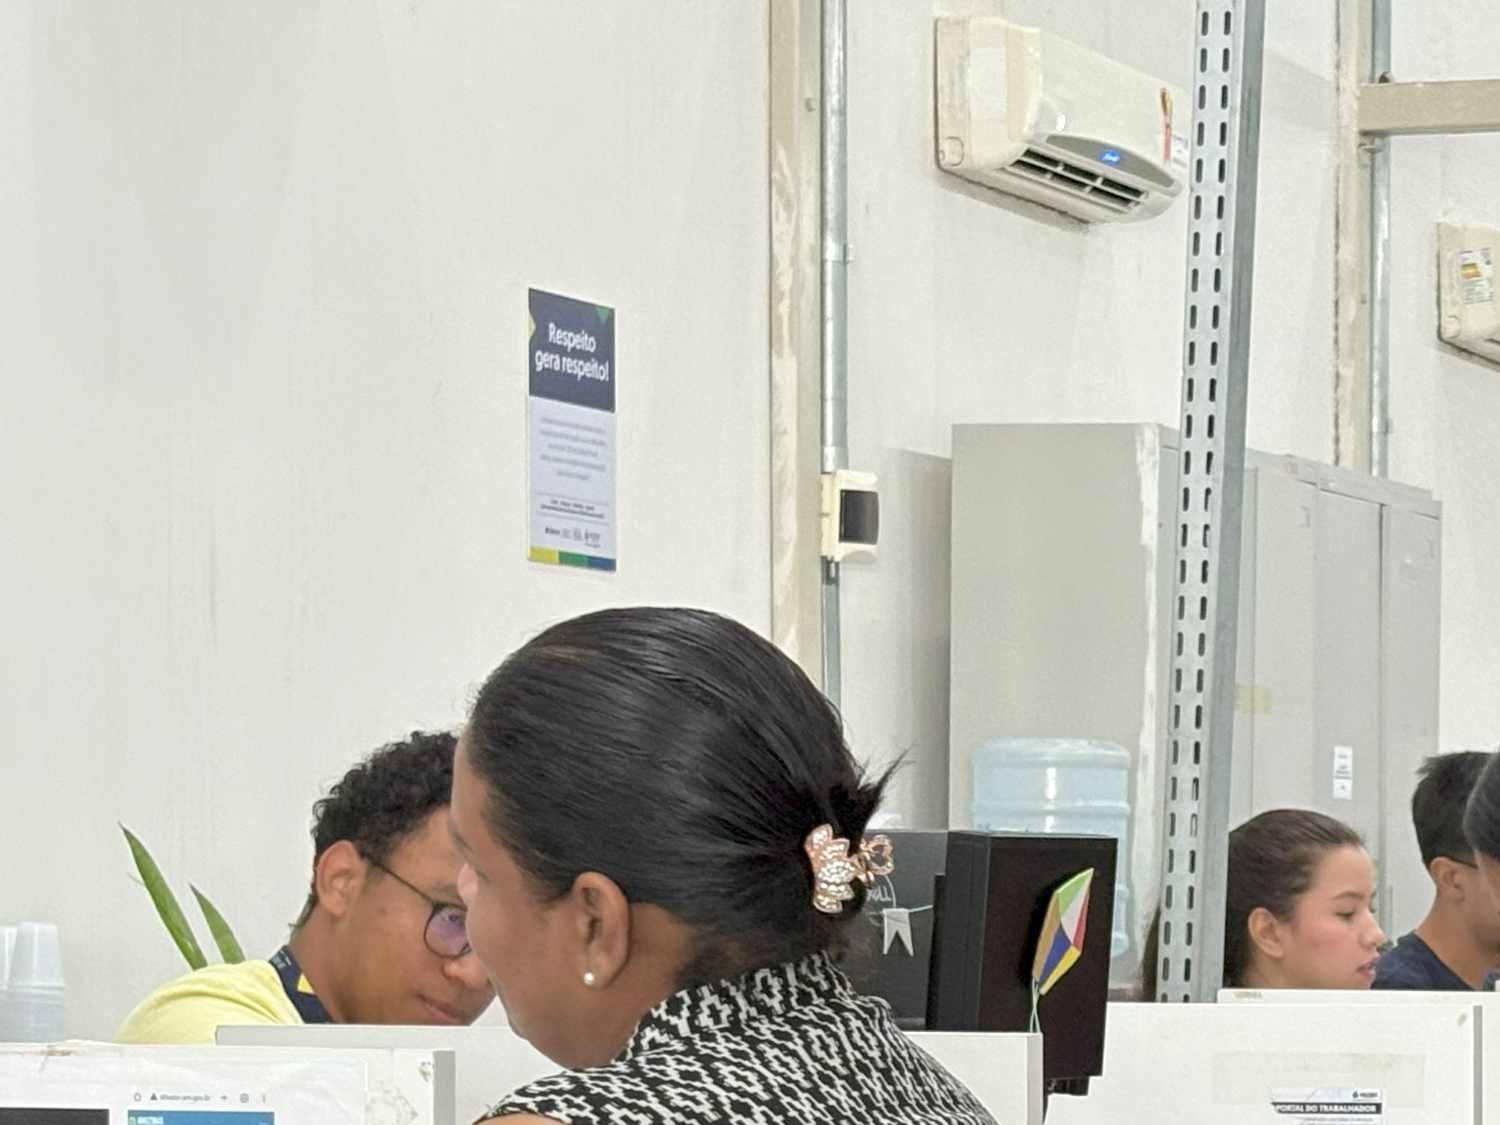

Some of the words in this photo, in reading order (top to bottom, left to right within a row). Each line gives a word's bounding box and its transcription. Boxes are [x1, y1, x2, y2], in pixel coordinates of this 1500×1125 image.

[548, 322, 596, 352] Respeito
[534, 350, 560, 372] gera
[562, 356, 609, 382] respeito!
